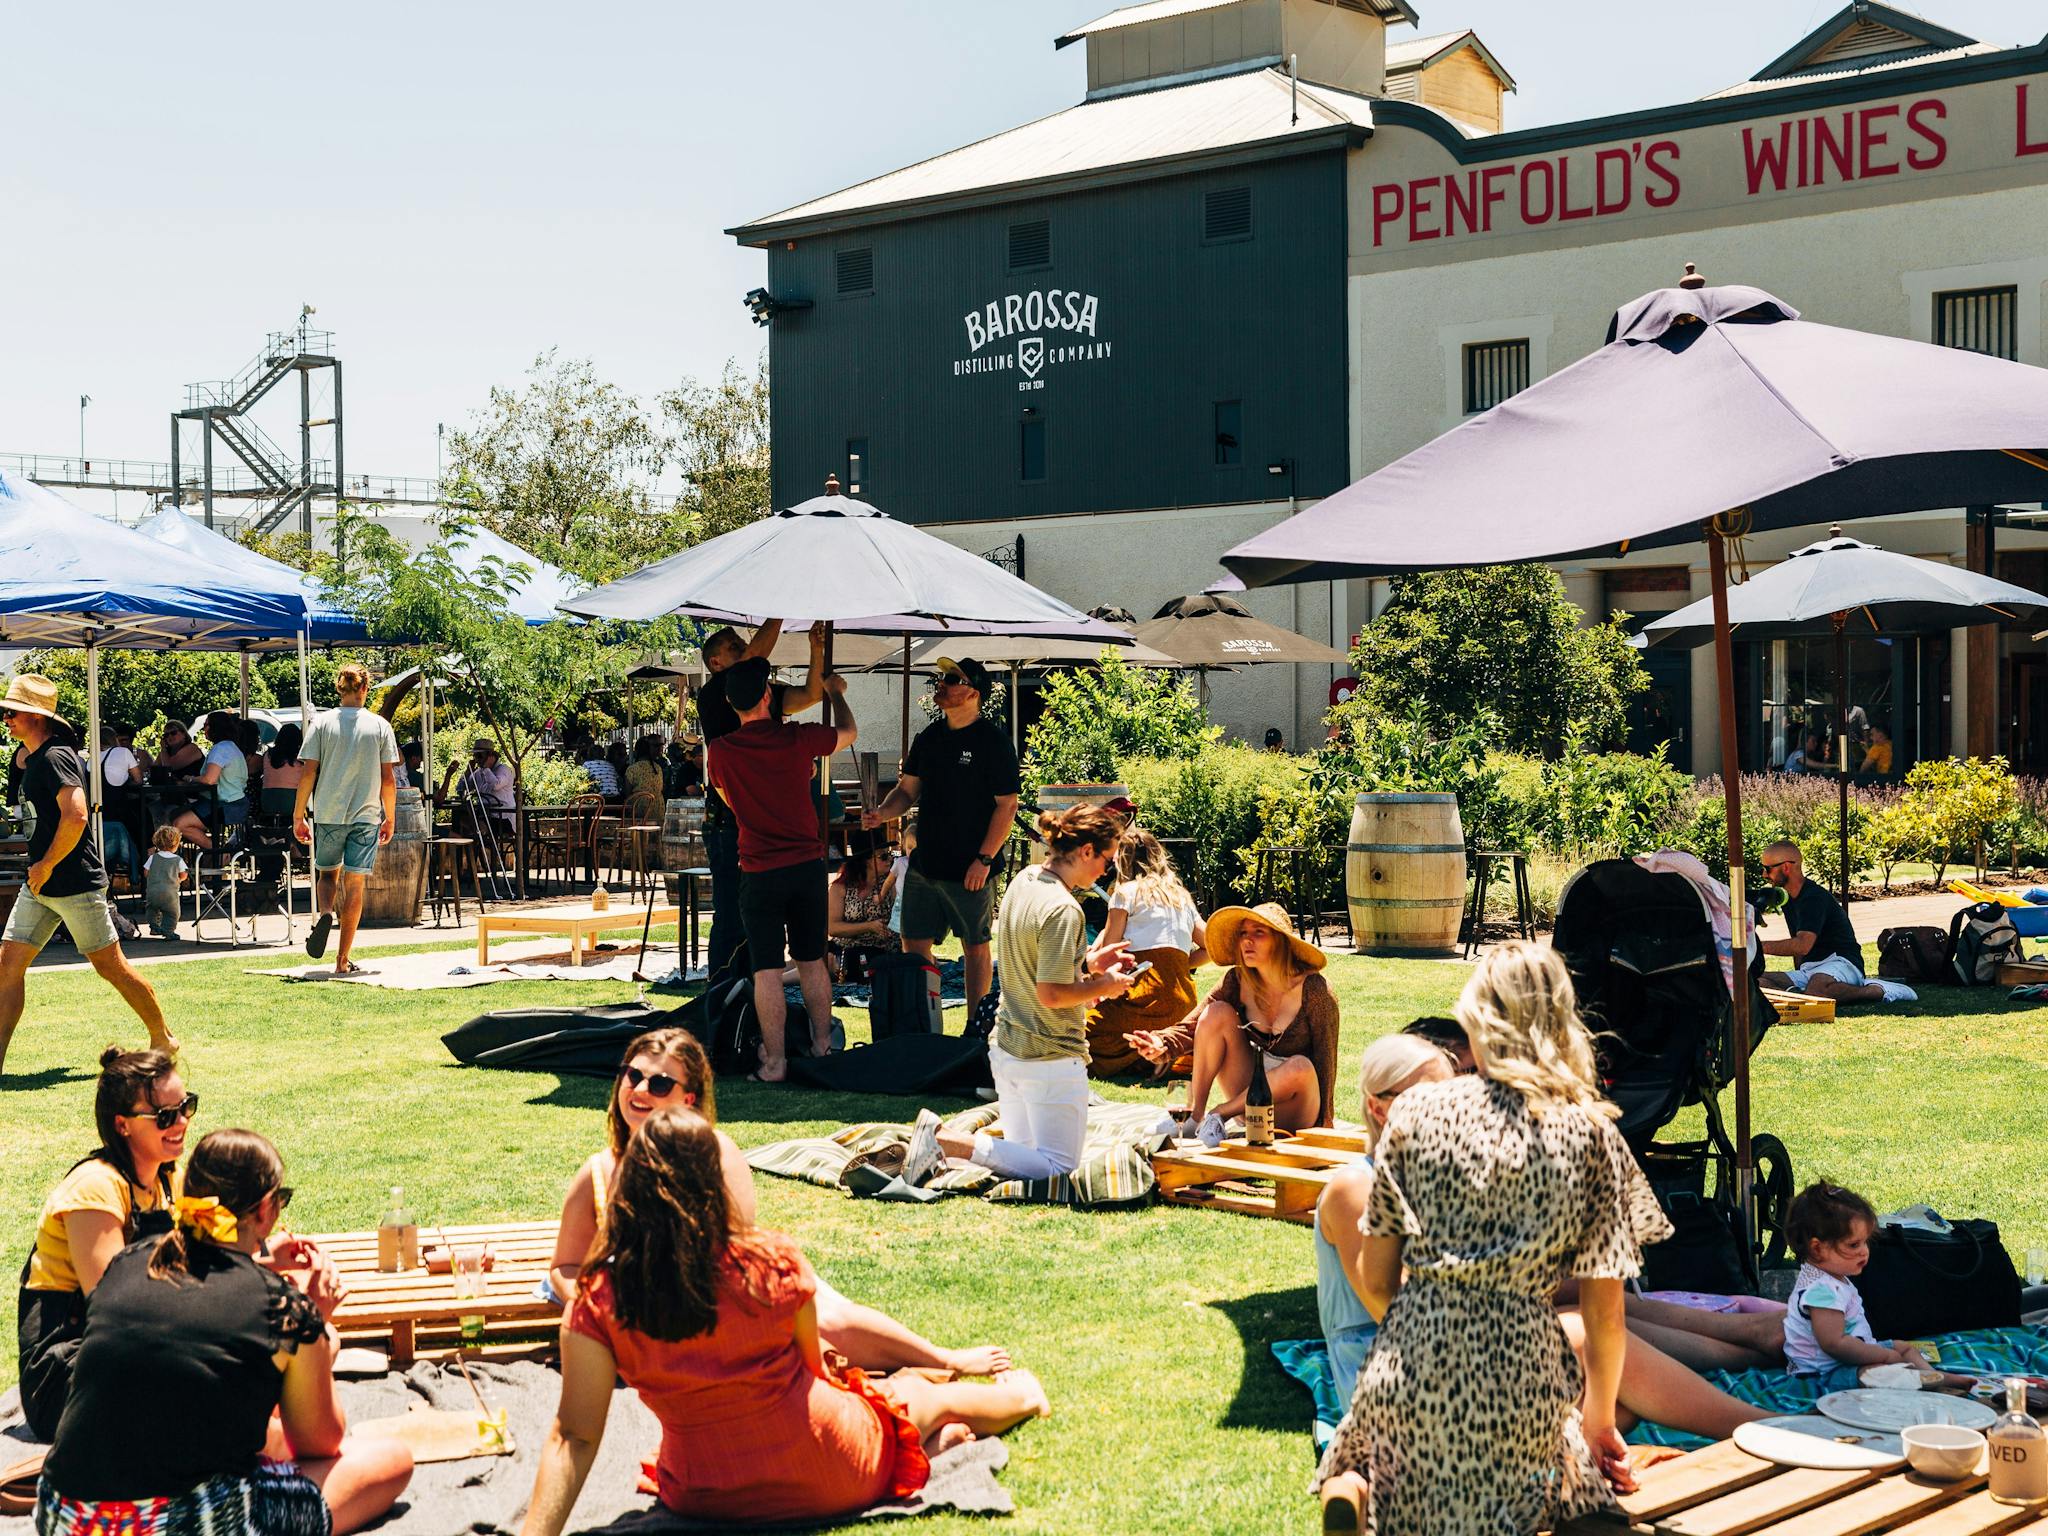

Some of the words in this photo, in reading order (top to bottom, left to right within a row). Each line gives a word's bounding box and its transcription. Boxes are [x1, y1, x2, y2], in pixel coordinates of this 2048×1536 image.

[1372, 140, 1680, 247] PENFOLD'S
[1743, 99, 1948, 195] WINES
[2015, 83, 2048, 157] L
[964, 289, 1099, 352] BAROSSA
[954, 354, 1014, 376] DISTILLING
[1049, 341, 1112, 365] COMPANY
[1221, 639, 1273, 649] BAROSSA
[1989, 1441, 2027, 1463] VED
